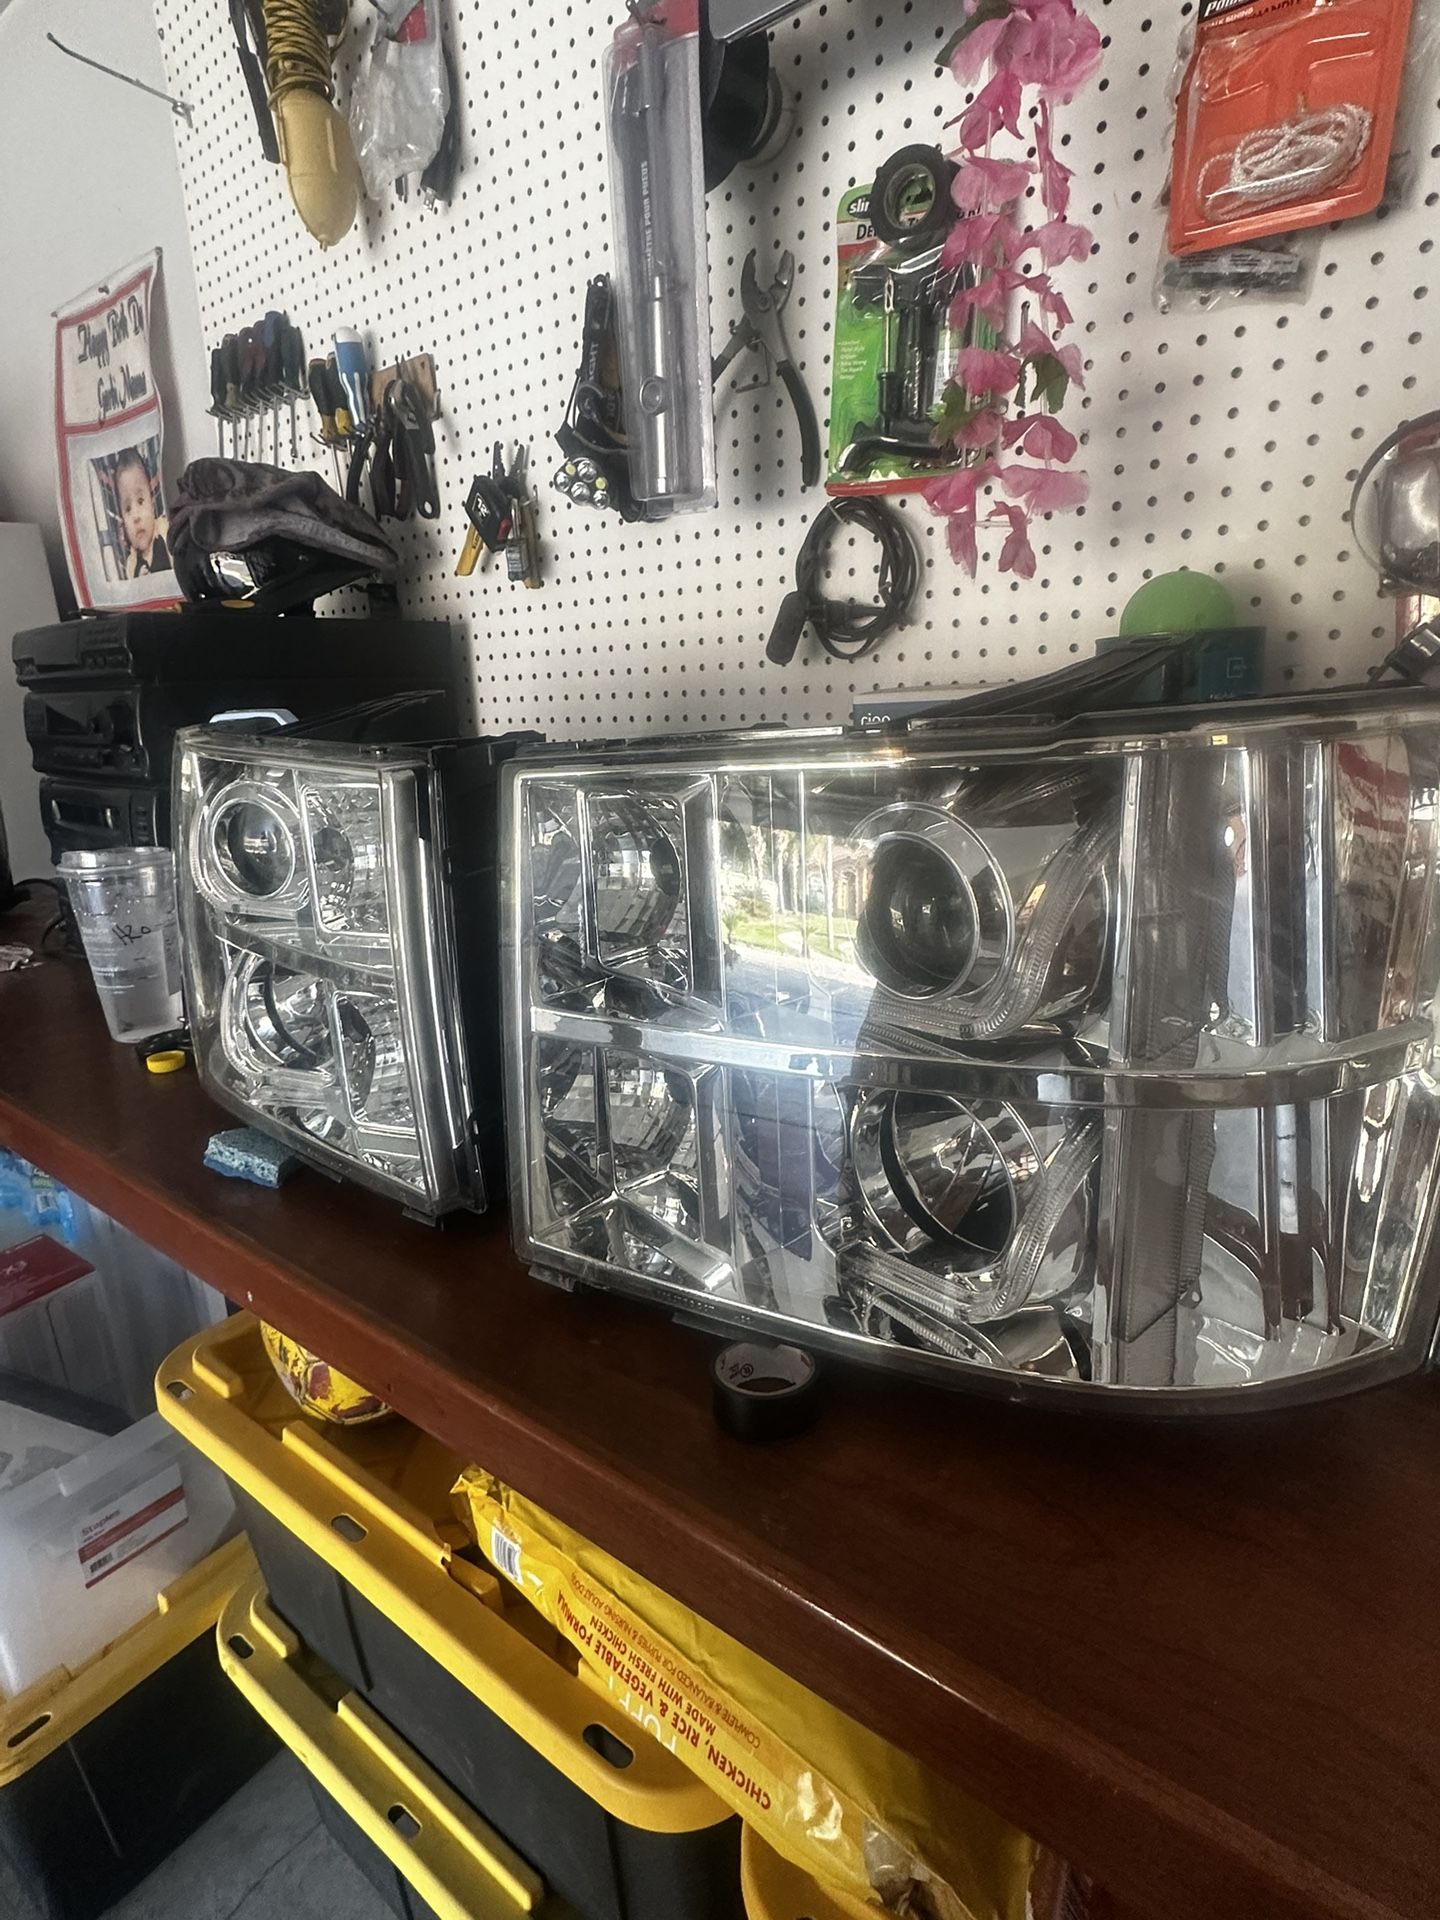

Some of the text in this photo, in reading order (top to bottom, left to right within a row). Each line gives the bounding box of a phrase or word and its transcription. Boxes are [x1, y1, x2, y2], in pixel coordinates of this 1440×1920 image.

[584, 1589, 604, 1609] ADULT
[558, 1590, 594, 1647] FORMULA
[590, 1615, 628, 1655] CHICKEN
[603, 1605, 632, 1636] NURSING
[638, 1635, 662, 1663] PUPPIES
[594, 1640, 654, 1707] VEGETABLE
[628, 1651, 657, 1683] FRESH
[662, 1658, 677, 1676] FOR
[658, 1677, 683, 1709] WITH
[677, 1670, 716, 1709] BALANCED
[659, 1699, 669, 1718] &
[685, 1703, 717, 1737] MADE
[714, 1703, 723, 1715] &
[671, 1712, 700, 1748] RICE
[722, 1709, 760, 1749] COMPLETE
[705, 1739, 771, 1810] CHICKEN,
